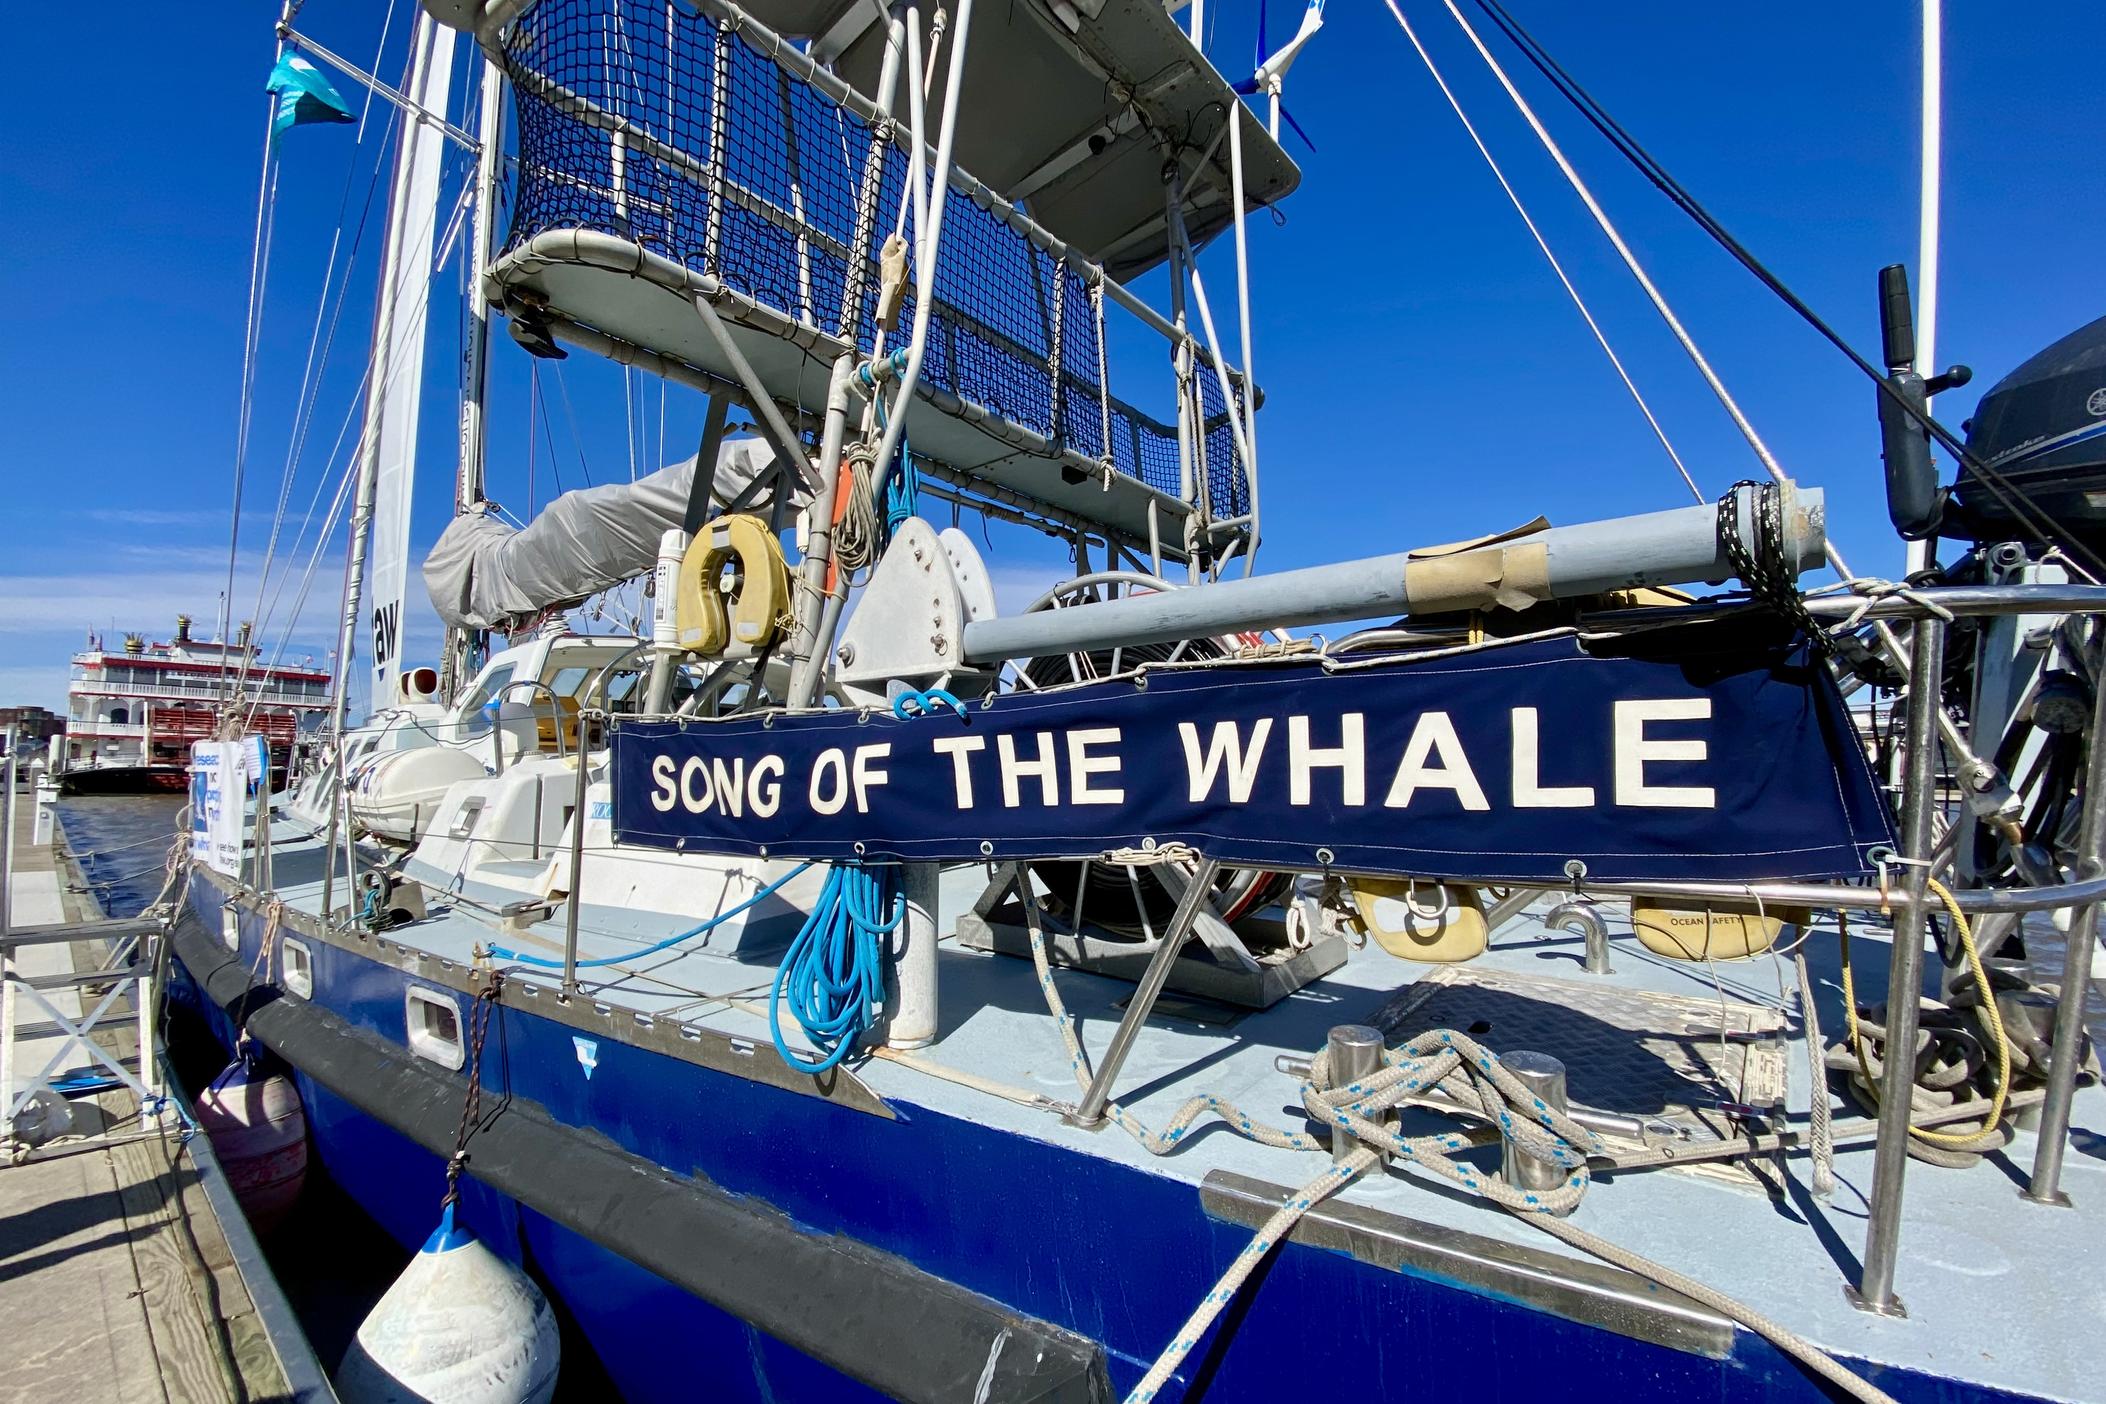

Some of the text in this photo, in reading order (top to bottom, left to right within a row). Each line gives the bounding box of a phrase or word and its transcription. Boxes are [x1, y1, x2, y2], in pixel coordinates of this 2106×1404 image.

[650, 697, 1716, 818] SONG OF THE WHALE
[1670, 916, 1742, 926] OCEAN AFETY
